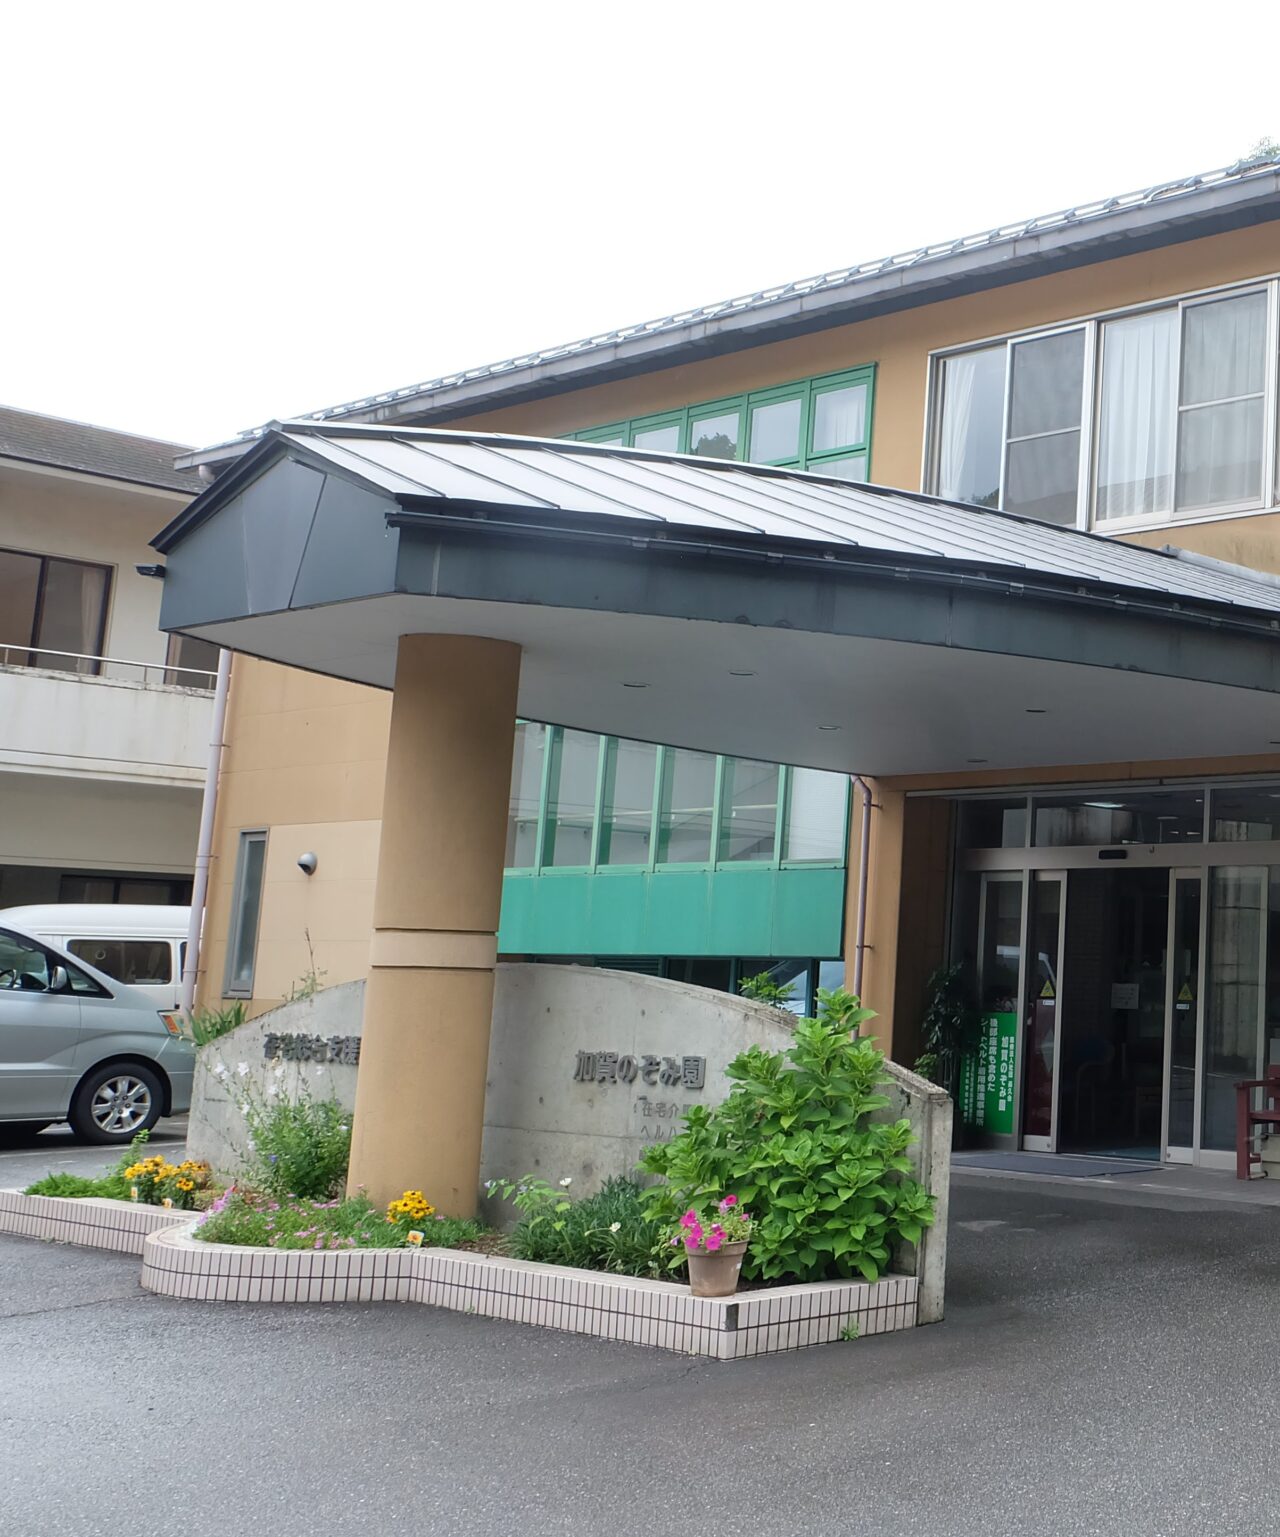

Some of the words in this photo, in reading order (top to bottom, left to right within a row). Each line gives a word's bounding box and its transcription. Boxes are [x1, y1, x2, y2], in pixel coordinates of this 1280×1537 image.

[573, 1050, 706, 1088] 加賀のぞみ園
[998, 1035, 1009, 1111] 加賀のぞみ園
[642, 1101, 691, 1118] 在宅介
